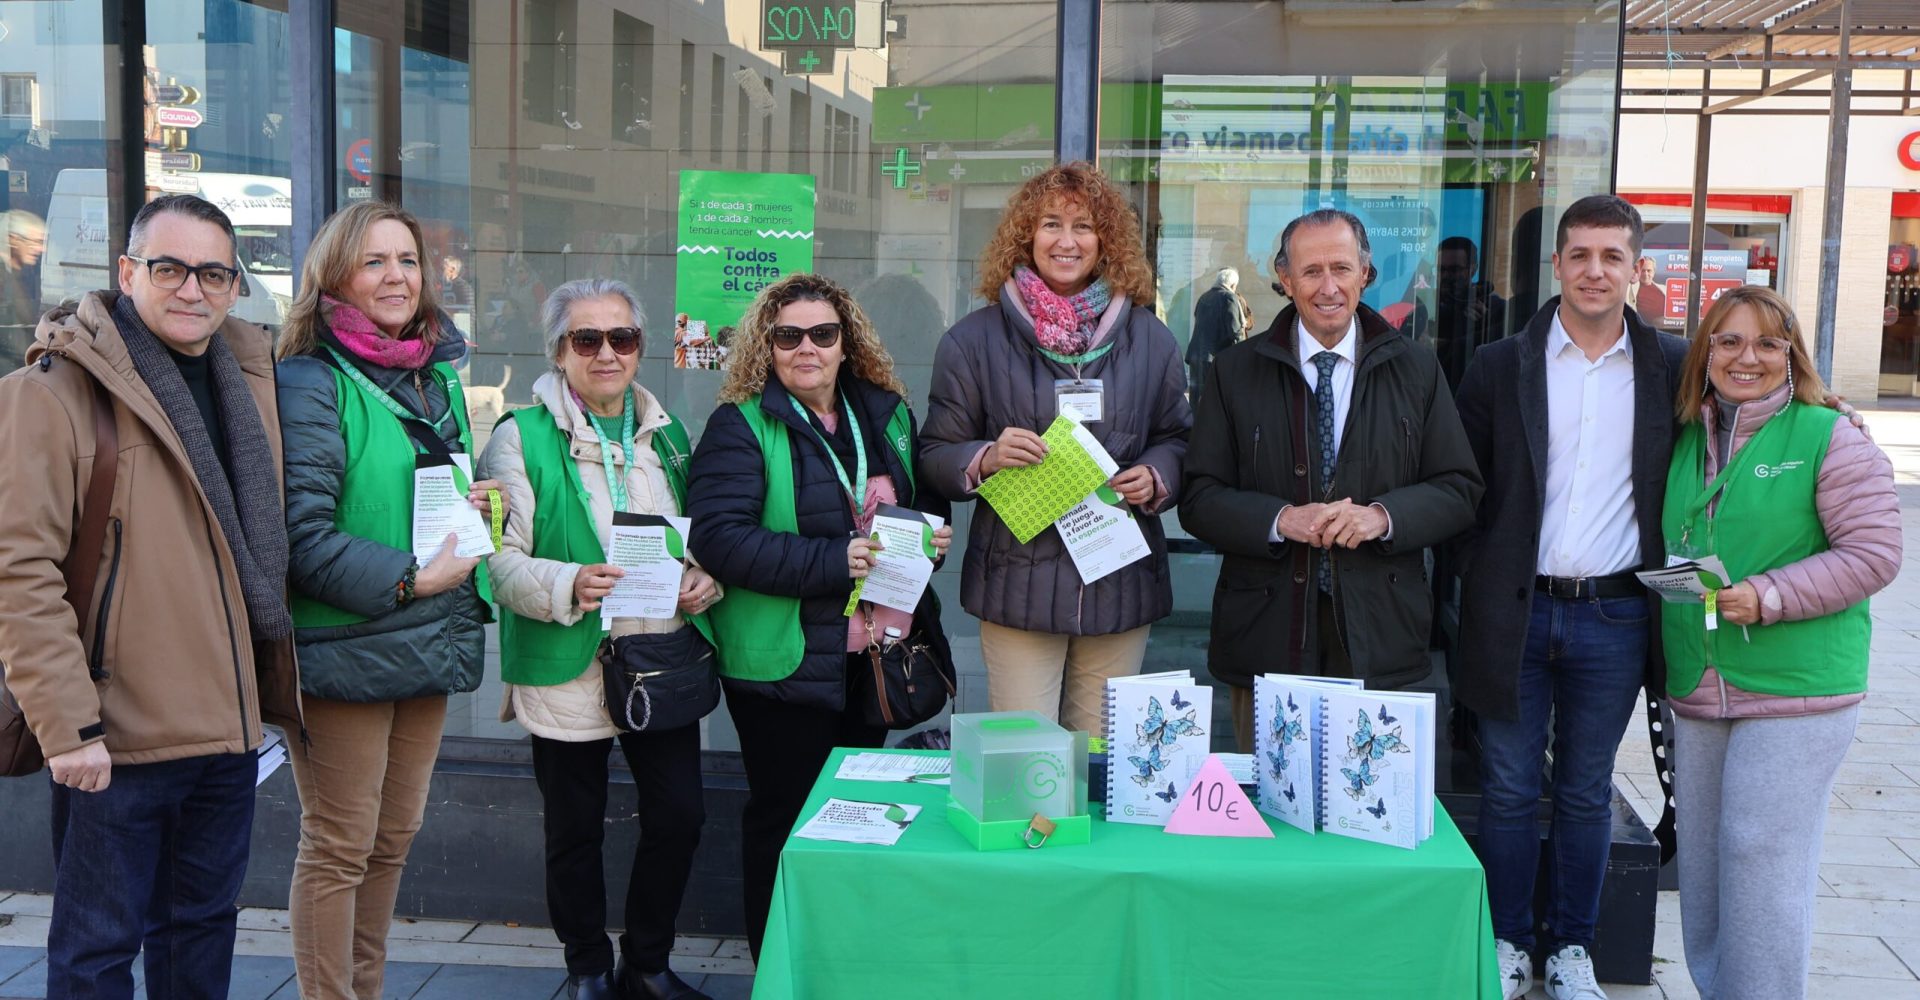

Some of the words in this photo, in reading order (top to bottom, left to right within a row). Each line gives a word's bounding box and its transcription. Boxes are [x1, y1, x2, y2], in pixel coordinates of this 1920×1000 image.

[700, 201, 705, 209] 1
[707, 200, 720, 210] de
[721, 201, 745, 210] cada
[746, 203, 753, 212] 3
[754, 203, 792, 213] mujeres
[697, 214, 702, 222] 1
[704, 213, 717, 222] de
[718, 213, 742, 223] cada
[743, 215, 750, 224] 2
[751, 215, 792, 224] hombres
[724, 247, 777, 262] Todos
[1677, 254, 1690, 262] Pla
[723, 264, 780, 277] contra
[1673, 263, 1690, 271] prec
[1710, 262, 1724, 271] hoy
[722, 276, 740, 292] el
[1058, 504, 1089, 525] jornada
[1061, 521, 1072, 530] se
[1072, 509, 1095, 527] juega
[1068, 537, 1078, 545] la
[1078, 516, 1119, 540] esperanza
[1071, 520, 1093, 535] favor
[1093, 514, 1104, 523] de
[1660, 576, 1694, 584] partido
[1191, 780, 1240, 821] 10€
